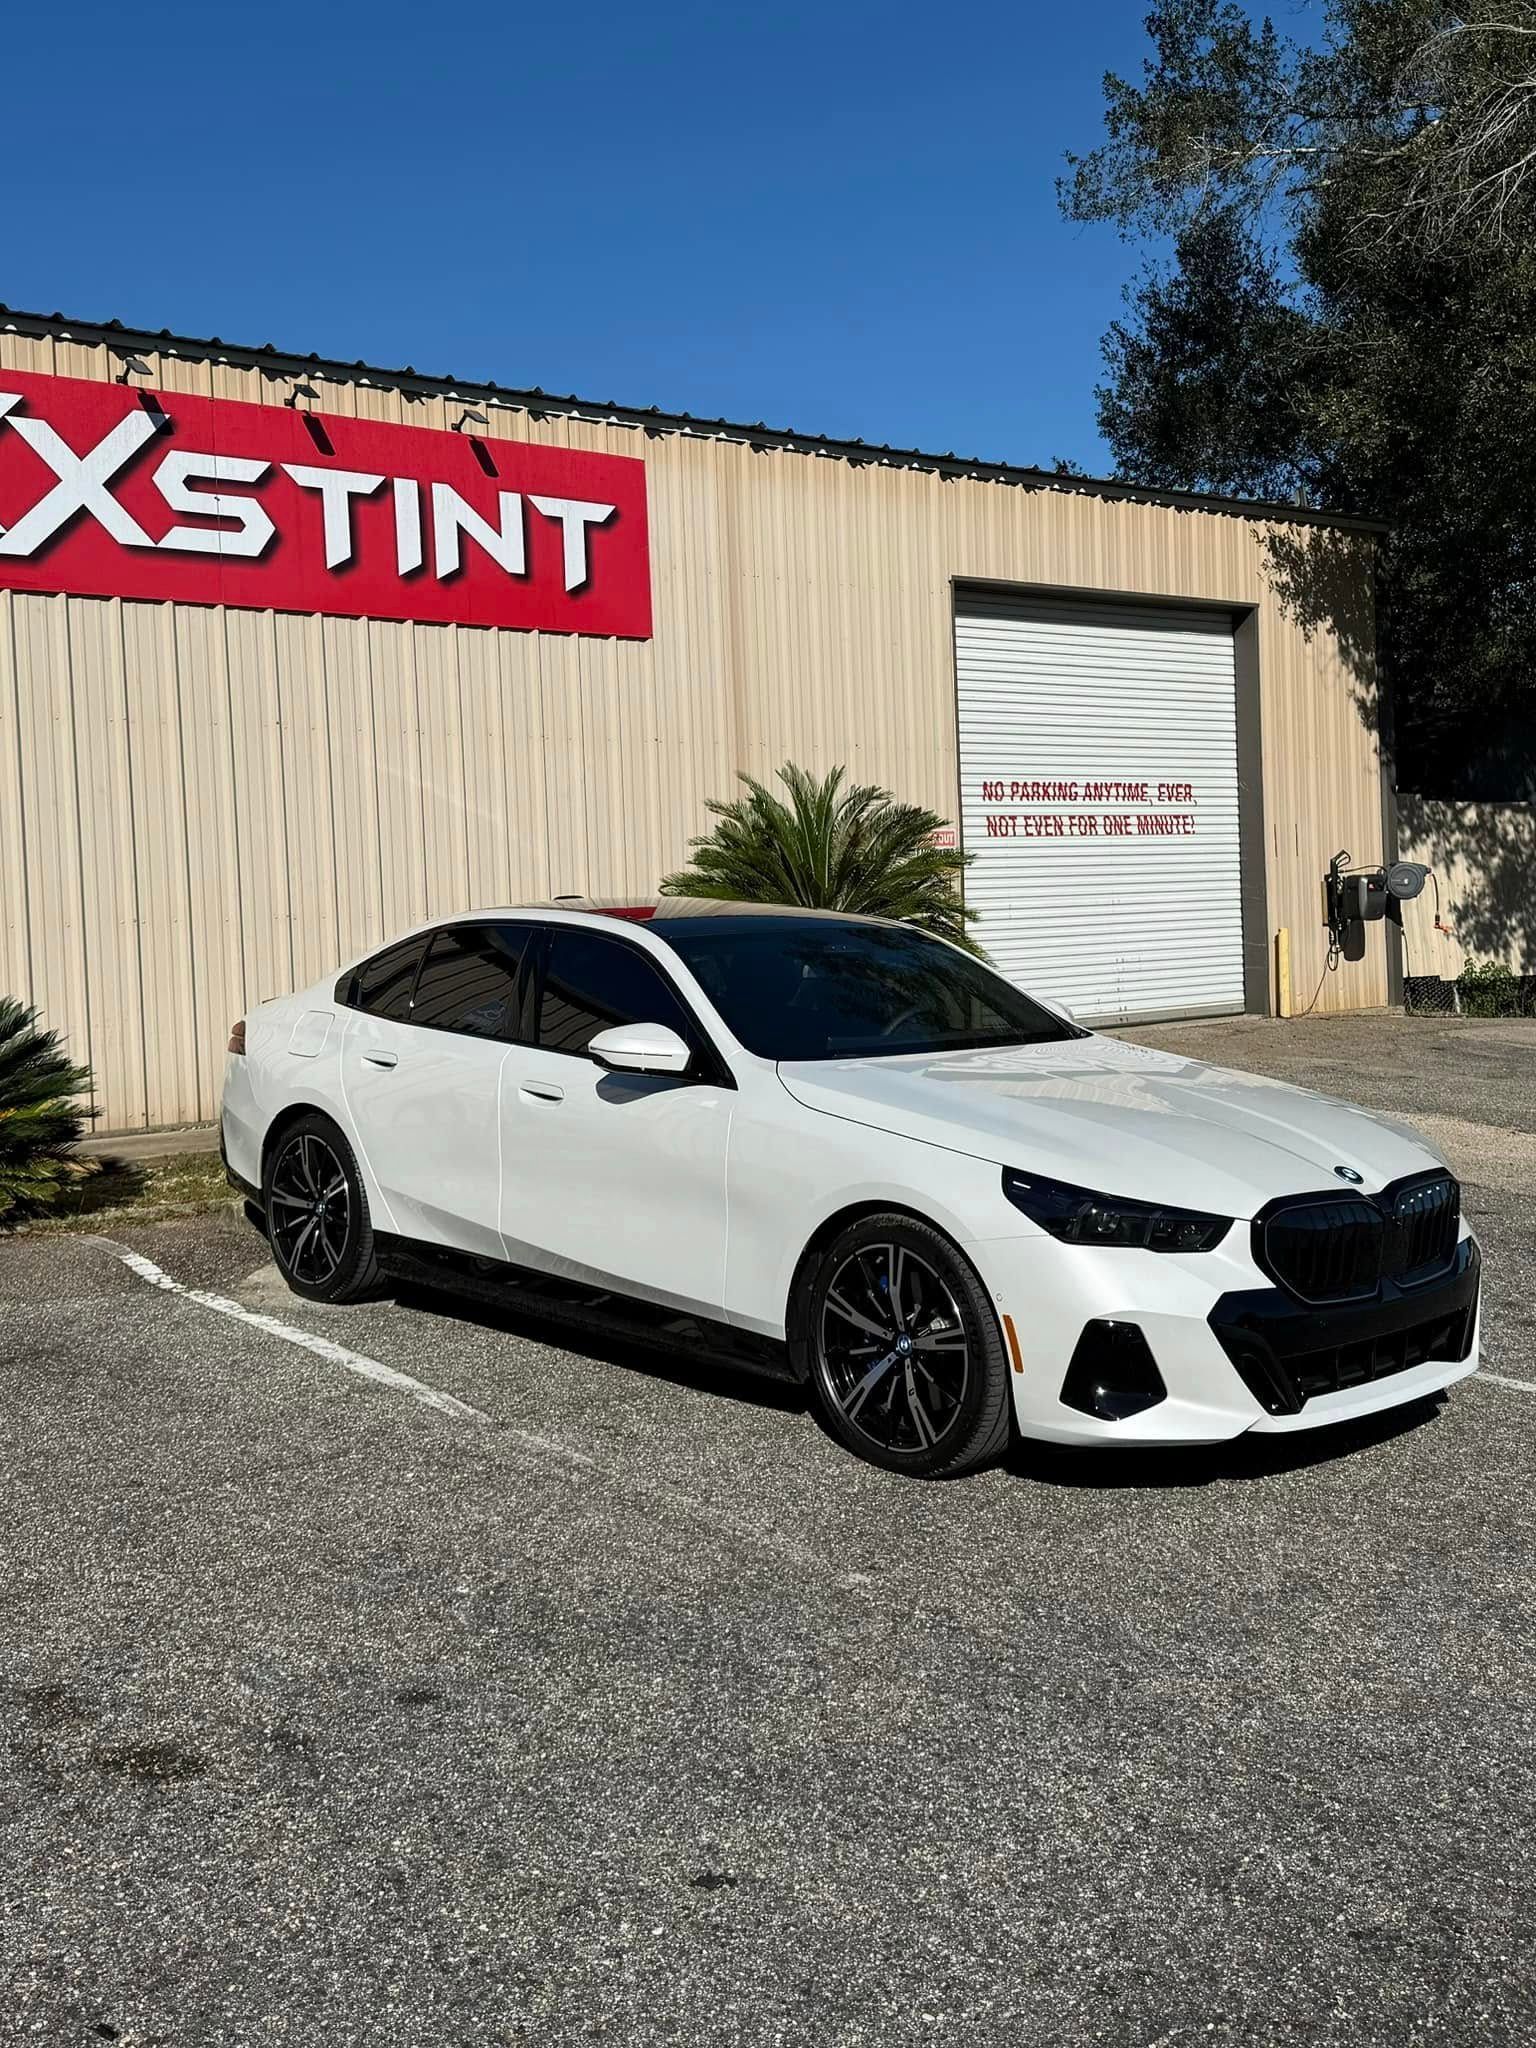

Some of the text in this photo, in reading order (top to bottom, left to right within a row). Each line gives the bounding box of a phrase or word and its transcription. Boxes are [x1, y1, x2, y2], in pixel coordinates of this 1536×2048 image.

[983, 781, 1197, 807] NO PARKING ANYTIME, EVER,
[986, 815, 1195, 837] NOT EVEN FOR ONE MINUTE!
